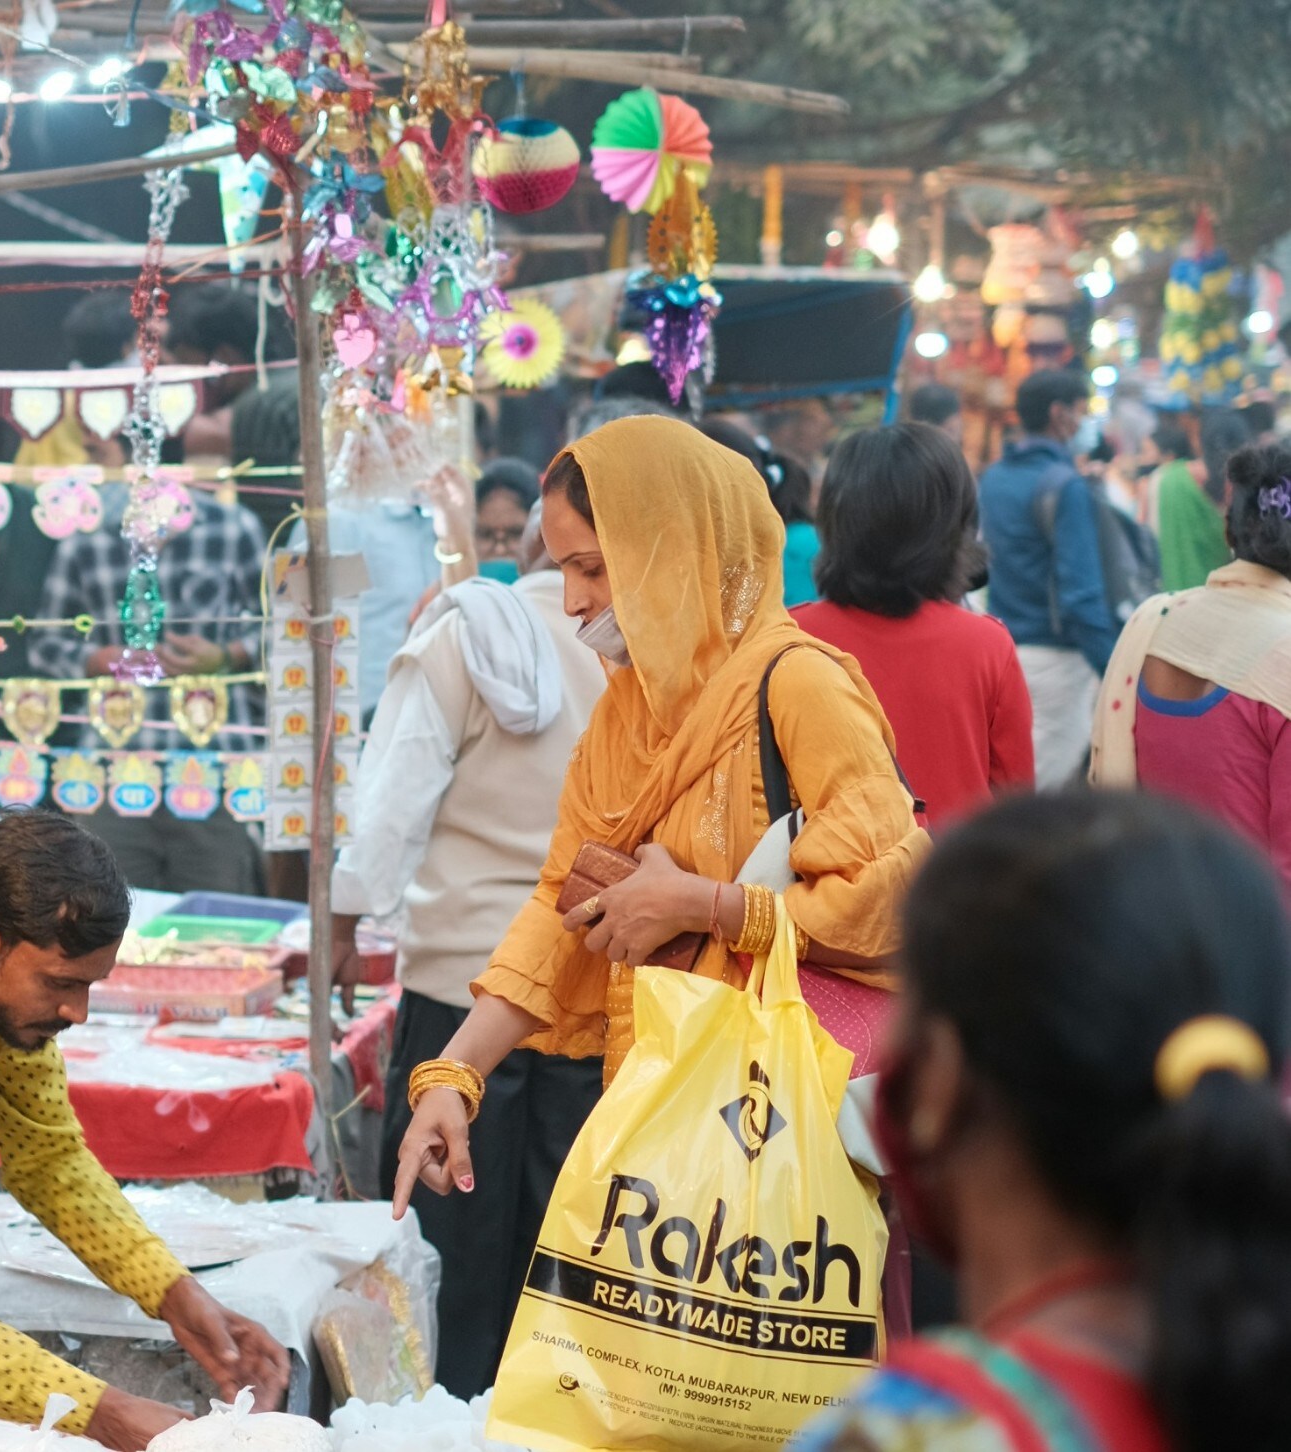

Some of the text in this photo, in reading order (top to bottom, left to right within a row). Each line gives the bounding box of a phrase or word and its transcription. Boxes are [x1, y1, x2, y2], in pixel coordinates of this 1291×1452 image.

[590, 1173, 861, 1308] Rakesh
[593, 1280, 847, 1350] READYMADE STORE
[531, 1330, 583, 1354] SHARMA
[586, 1346, 641, 1373] COMPLEX,
[645, 1363, 685, 1383] KOTLA
[688, 1375, 778, 1403] MUBARAKPUR,
[782, 1392, 811, 1404] NEW
[684, 1389, 752, 1411] 9999915152
[668, 1418, 695, 1430] REDUCE
[736, 1431, 745, 1439] TO
[745, 1433, 757, 1441] THE
